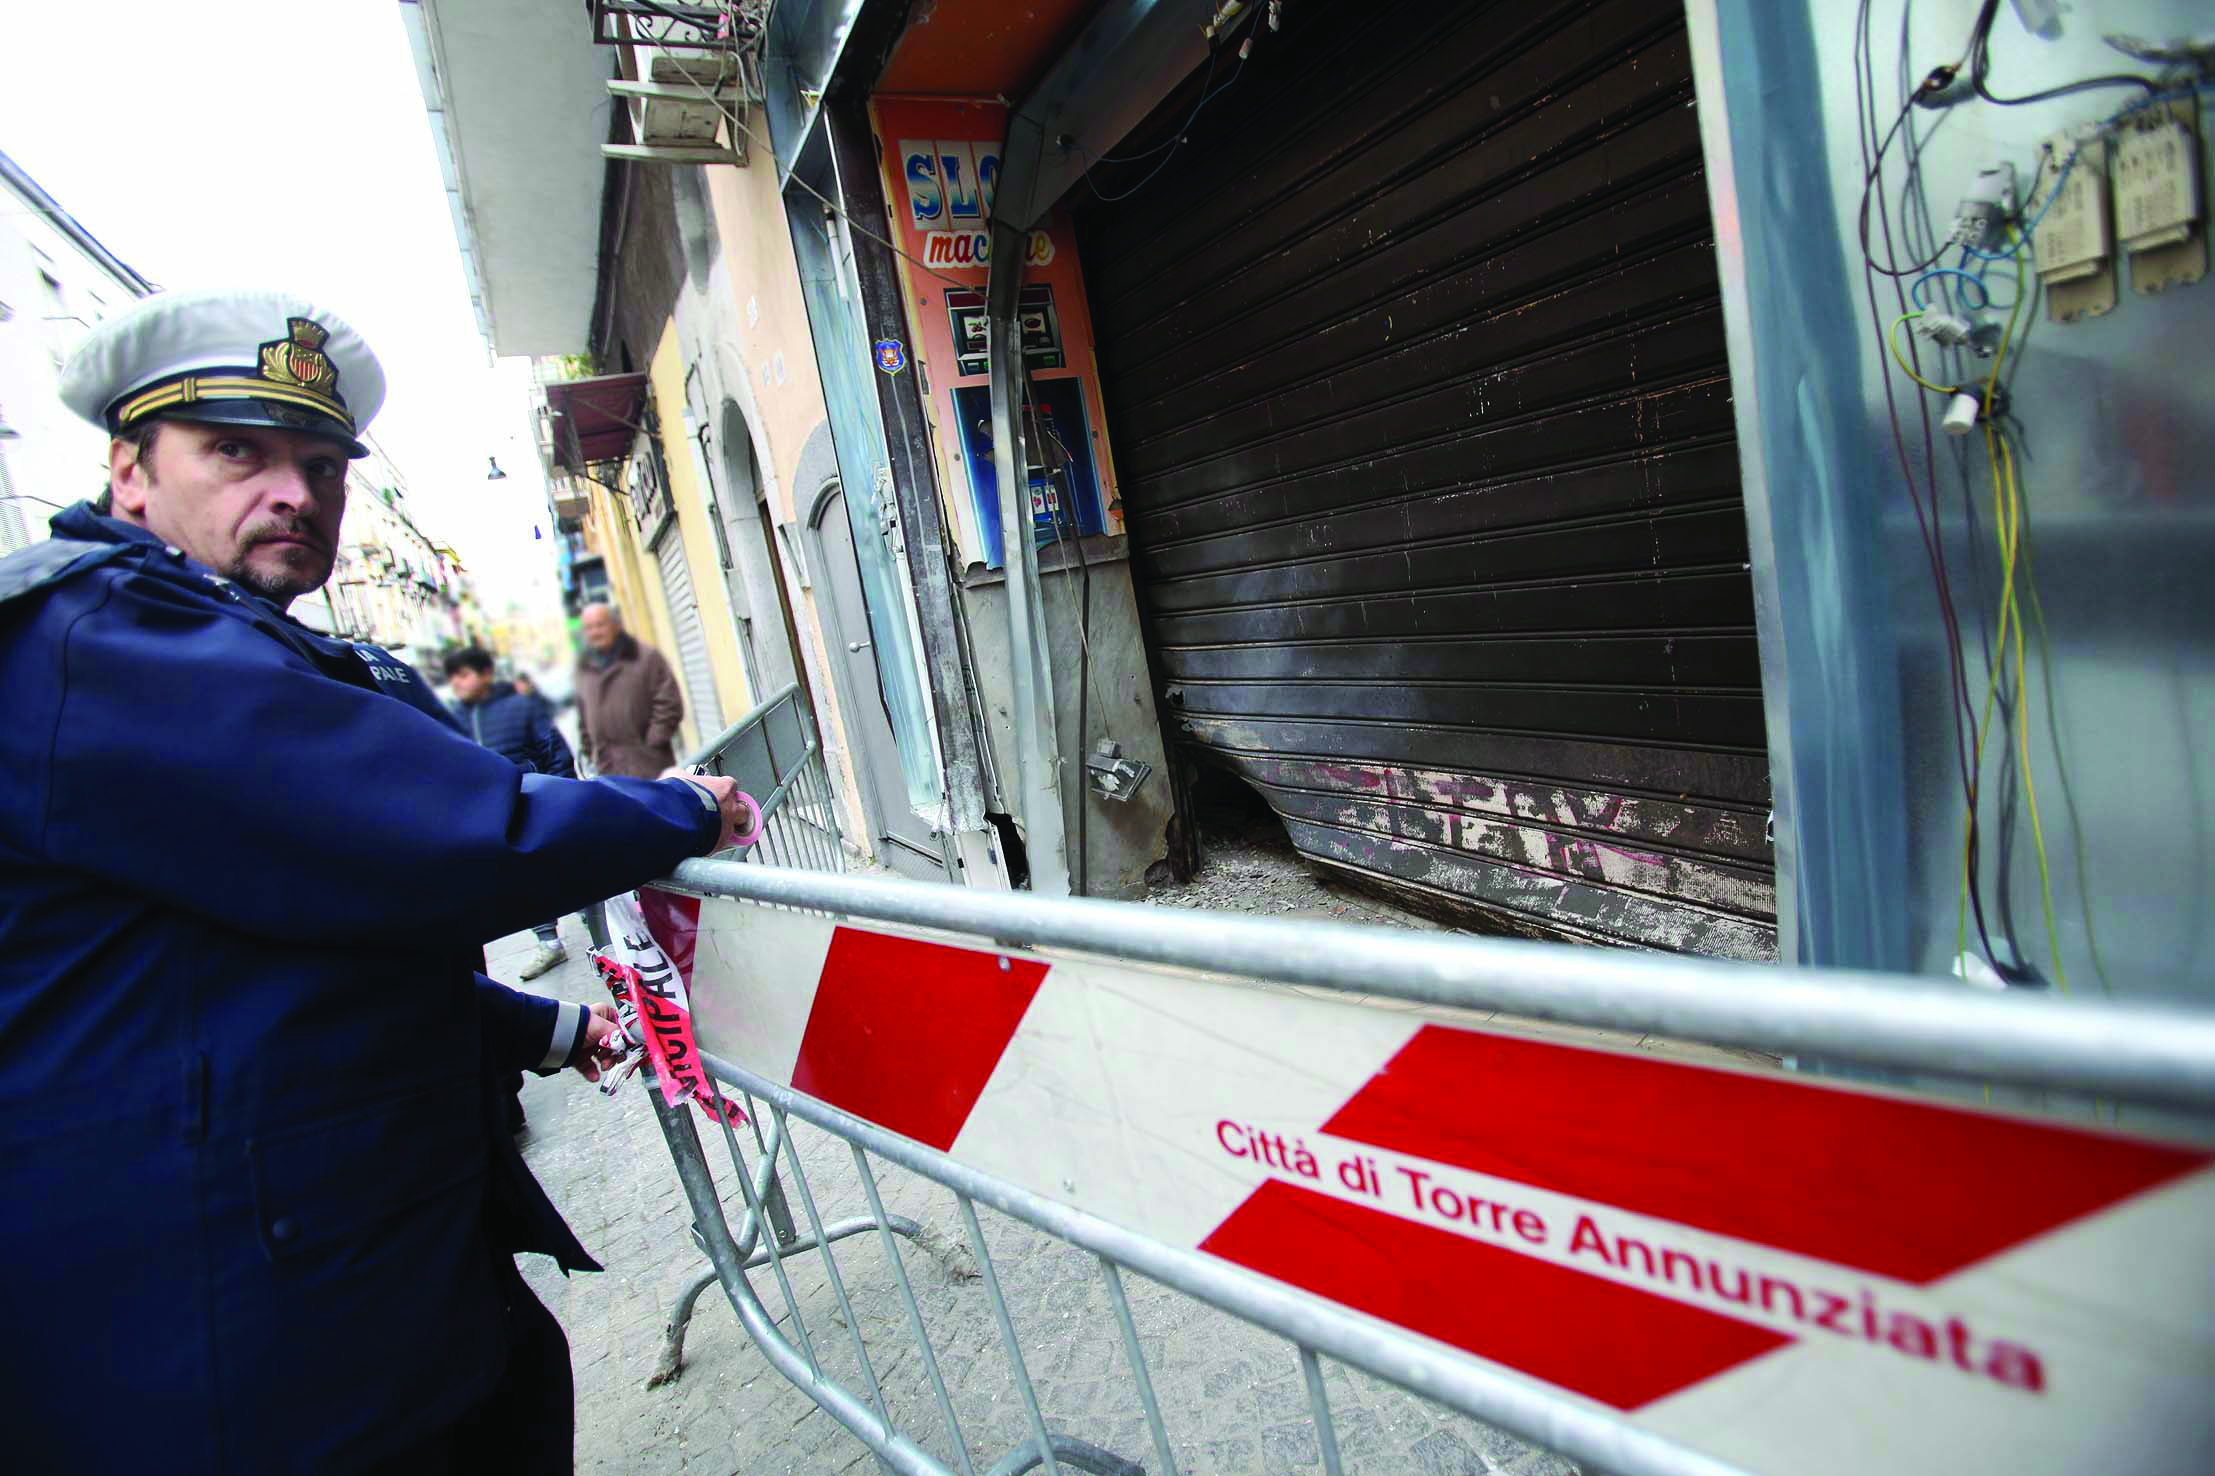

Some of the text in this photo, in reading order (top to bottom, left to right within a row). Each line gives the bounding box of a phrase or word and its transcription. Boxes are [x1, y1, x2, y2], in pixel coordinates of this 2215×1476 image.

[1216, 1119, 2048, 1394] Città di Torre Annunziata
